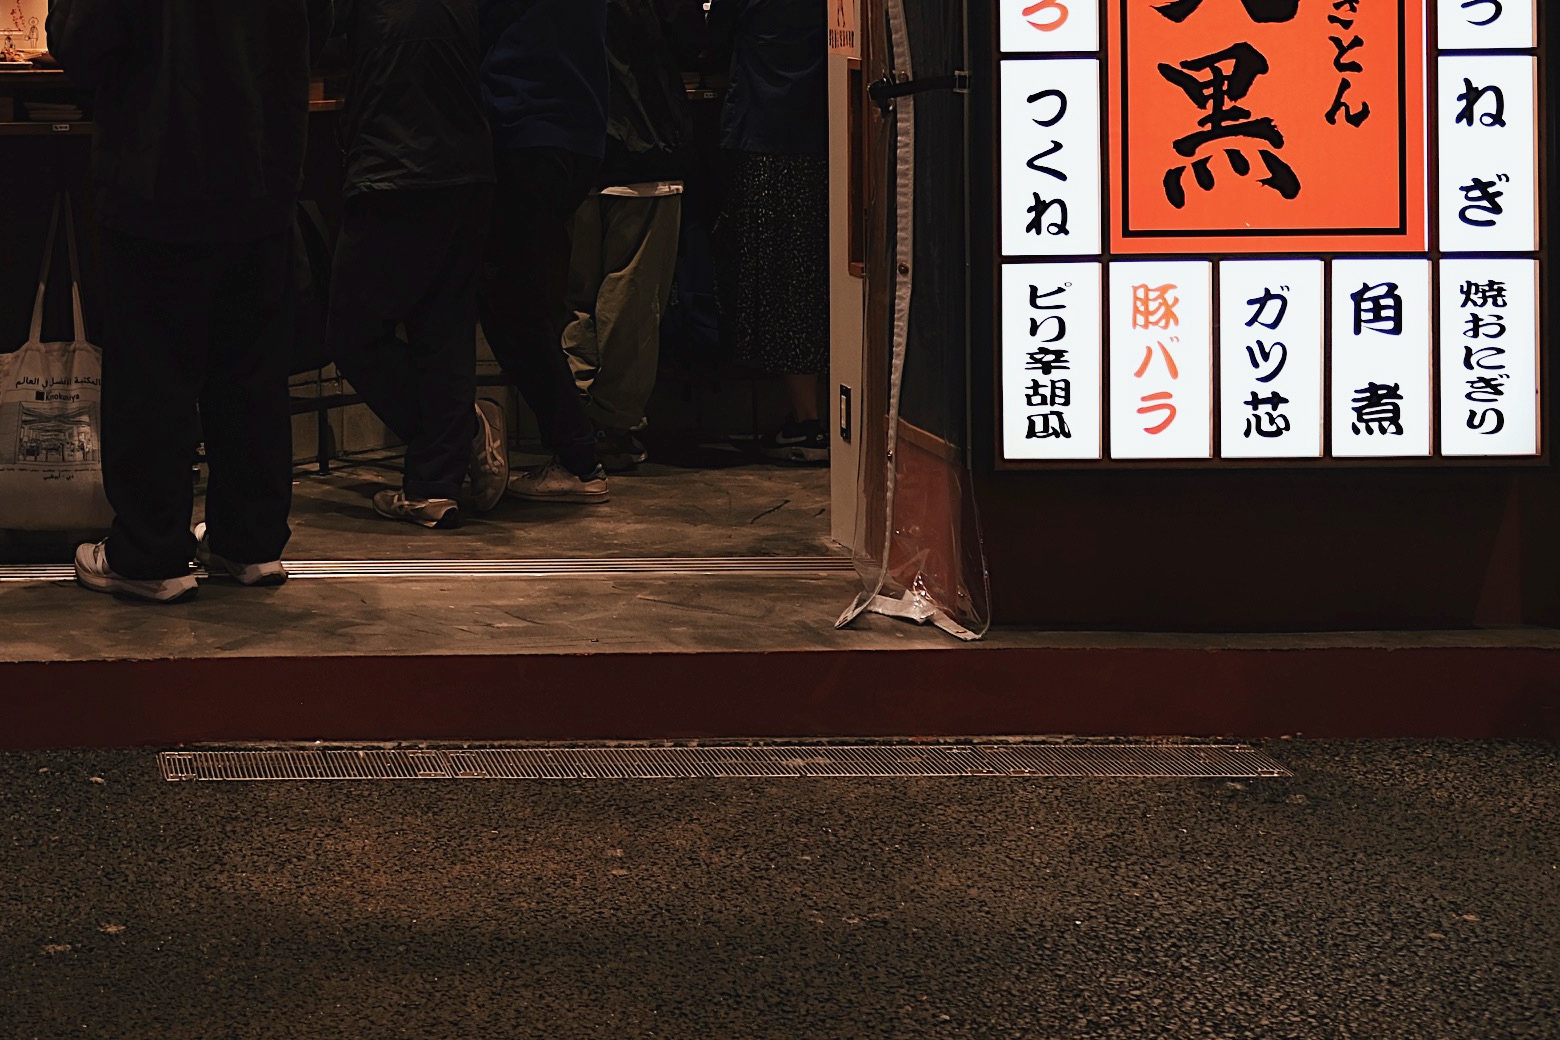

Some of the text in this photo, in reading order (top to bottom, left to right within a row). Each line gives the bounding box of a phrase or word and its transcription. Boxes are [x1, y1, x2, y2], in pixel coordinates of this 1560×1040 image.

[1026, 89, 1069, 236] つくね
[1455, 78, 1509, 227] ねぎ
[1025, 282, 1072, 439] ピリ辛胡瓜
[1132, 284, 1179, 434] 豚バラ
[1243, 285, 1290, 438] ガツ芯
[1350, 282, 1403, 435] 角煮
[1460, 280, 1510, 434] 焼おにぎり
